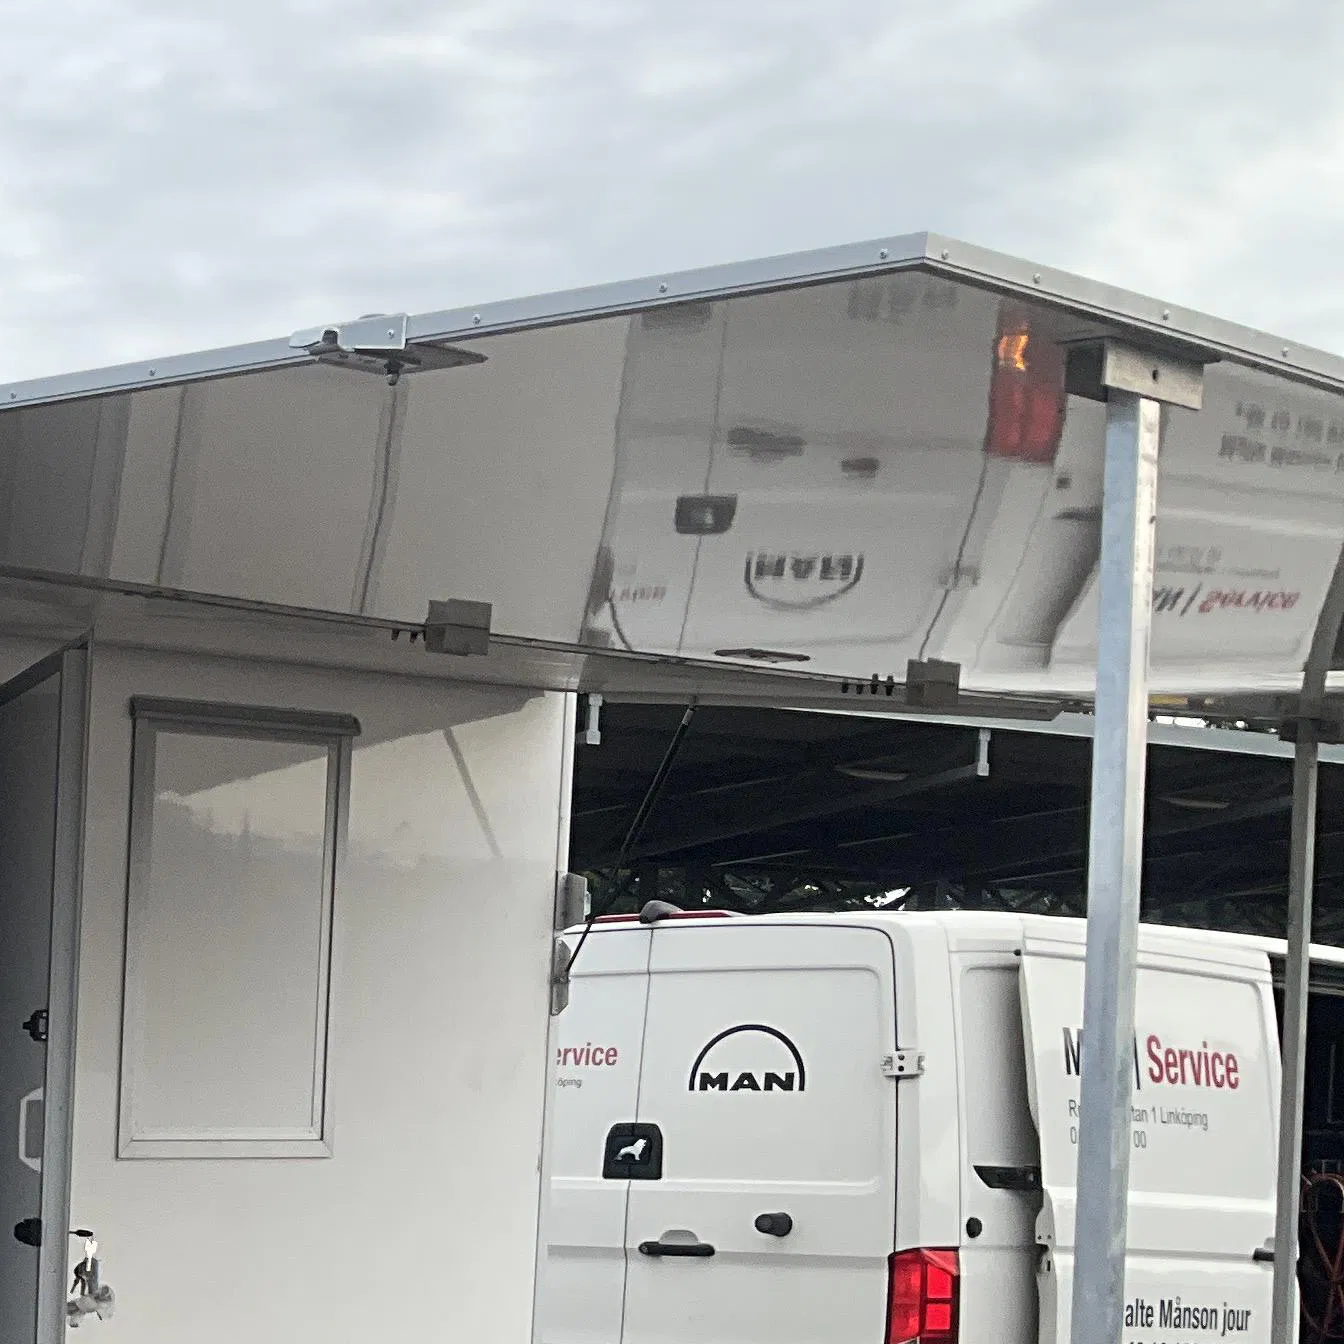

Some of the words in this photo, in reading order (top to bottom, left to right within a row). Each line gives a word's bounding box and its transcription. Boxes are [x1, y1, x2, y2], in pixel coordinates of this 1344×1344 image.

[556, 1042, 618, 1066] rvice
[1146, 1034, 1240, 1089] Service
[699, 1072, 795, 1091] MAN
[1125, 1298, 1154, 1328] alte
[1159, 1296, 1218, 1330] Månson
[1221, 1302, 1252, 1337] jour
